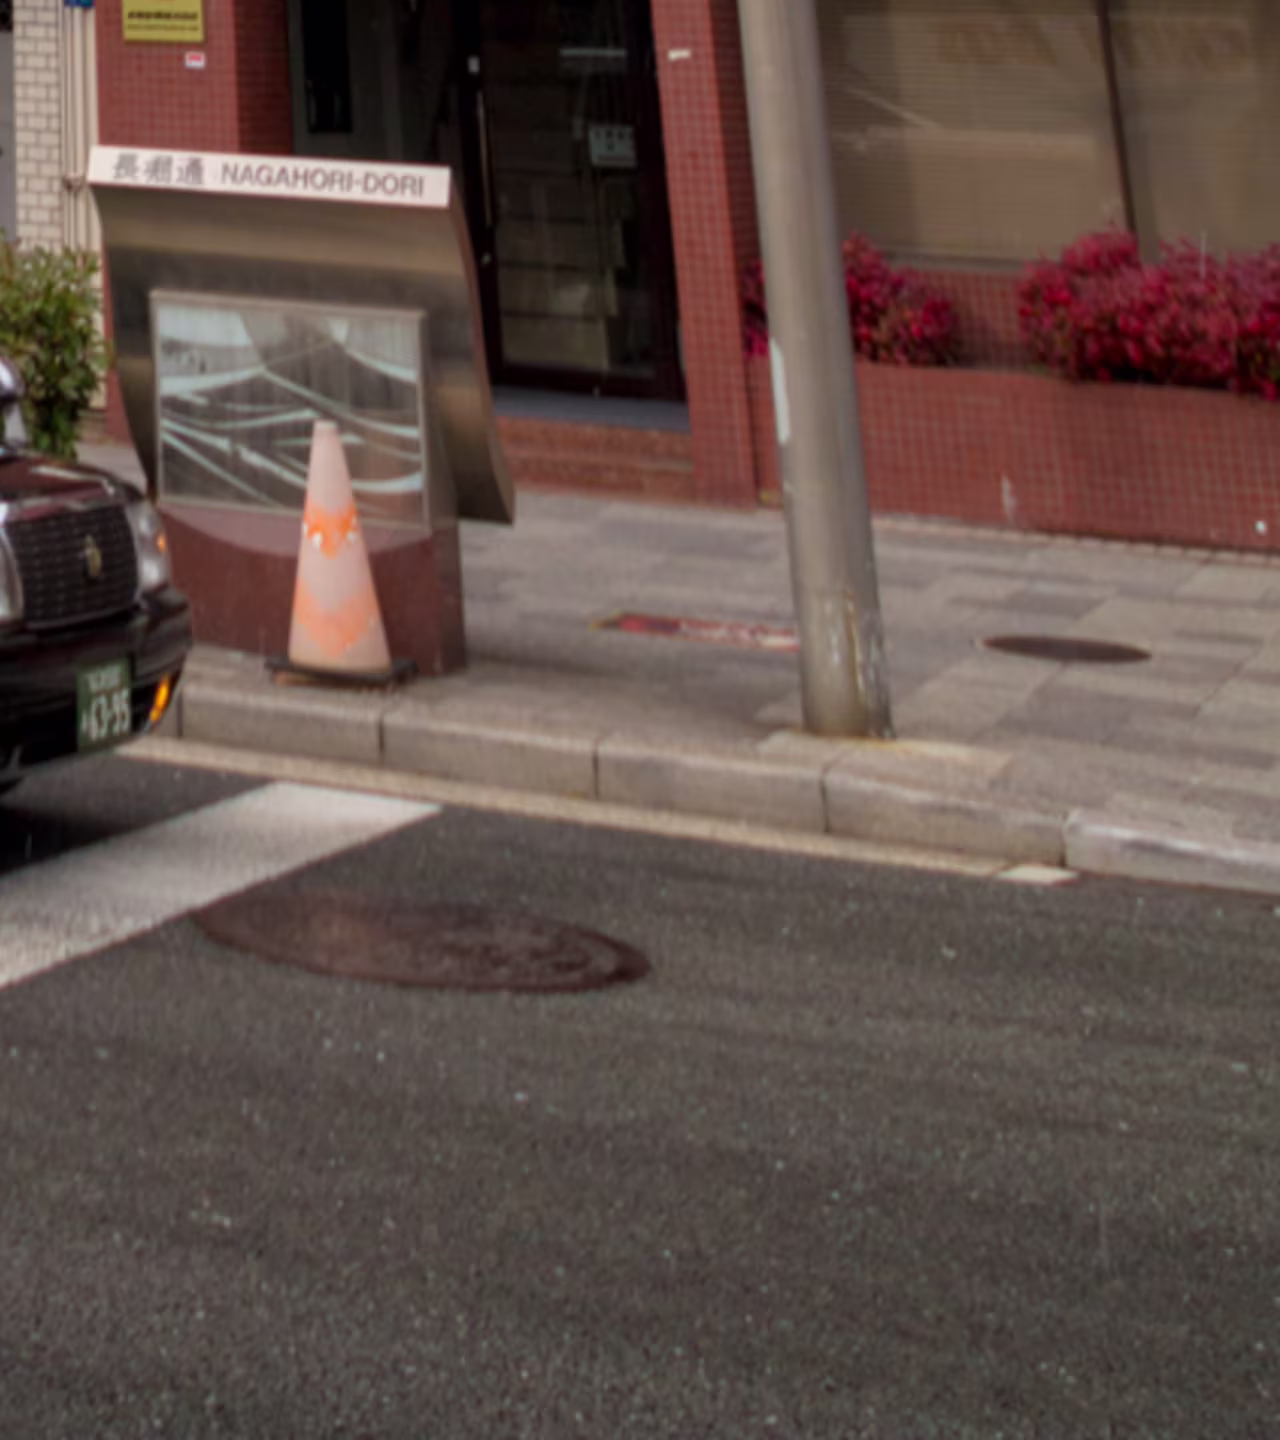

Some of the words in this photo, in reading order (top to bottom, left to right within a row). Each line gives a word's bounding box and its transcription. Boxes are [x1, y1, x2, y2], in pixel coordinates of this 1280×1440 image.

[112, 154, 205, 185] 長堀通
[221, 162, 425, 198] NAGAHORI-DORI
